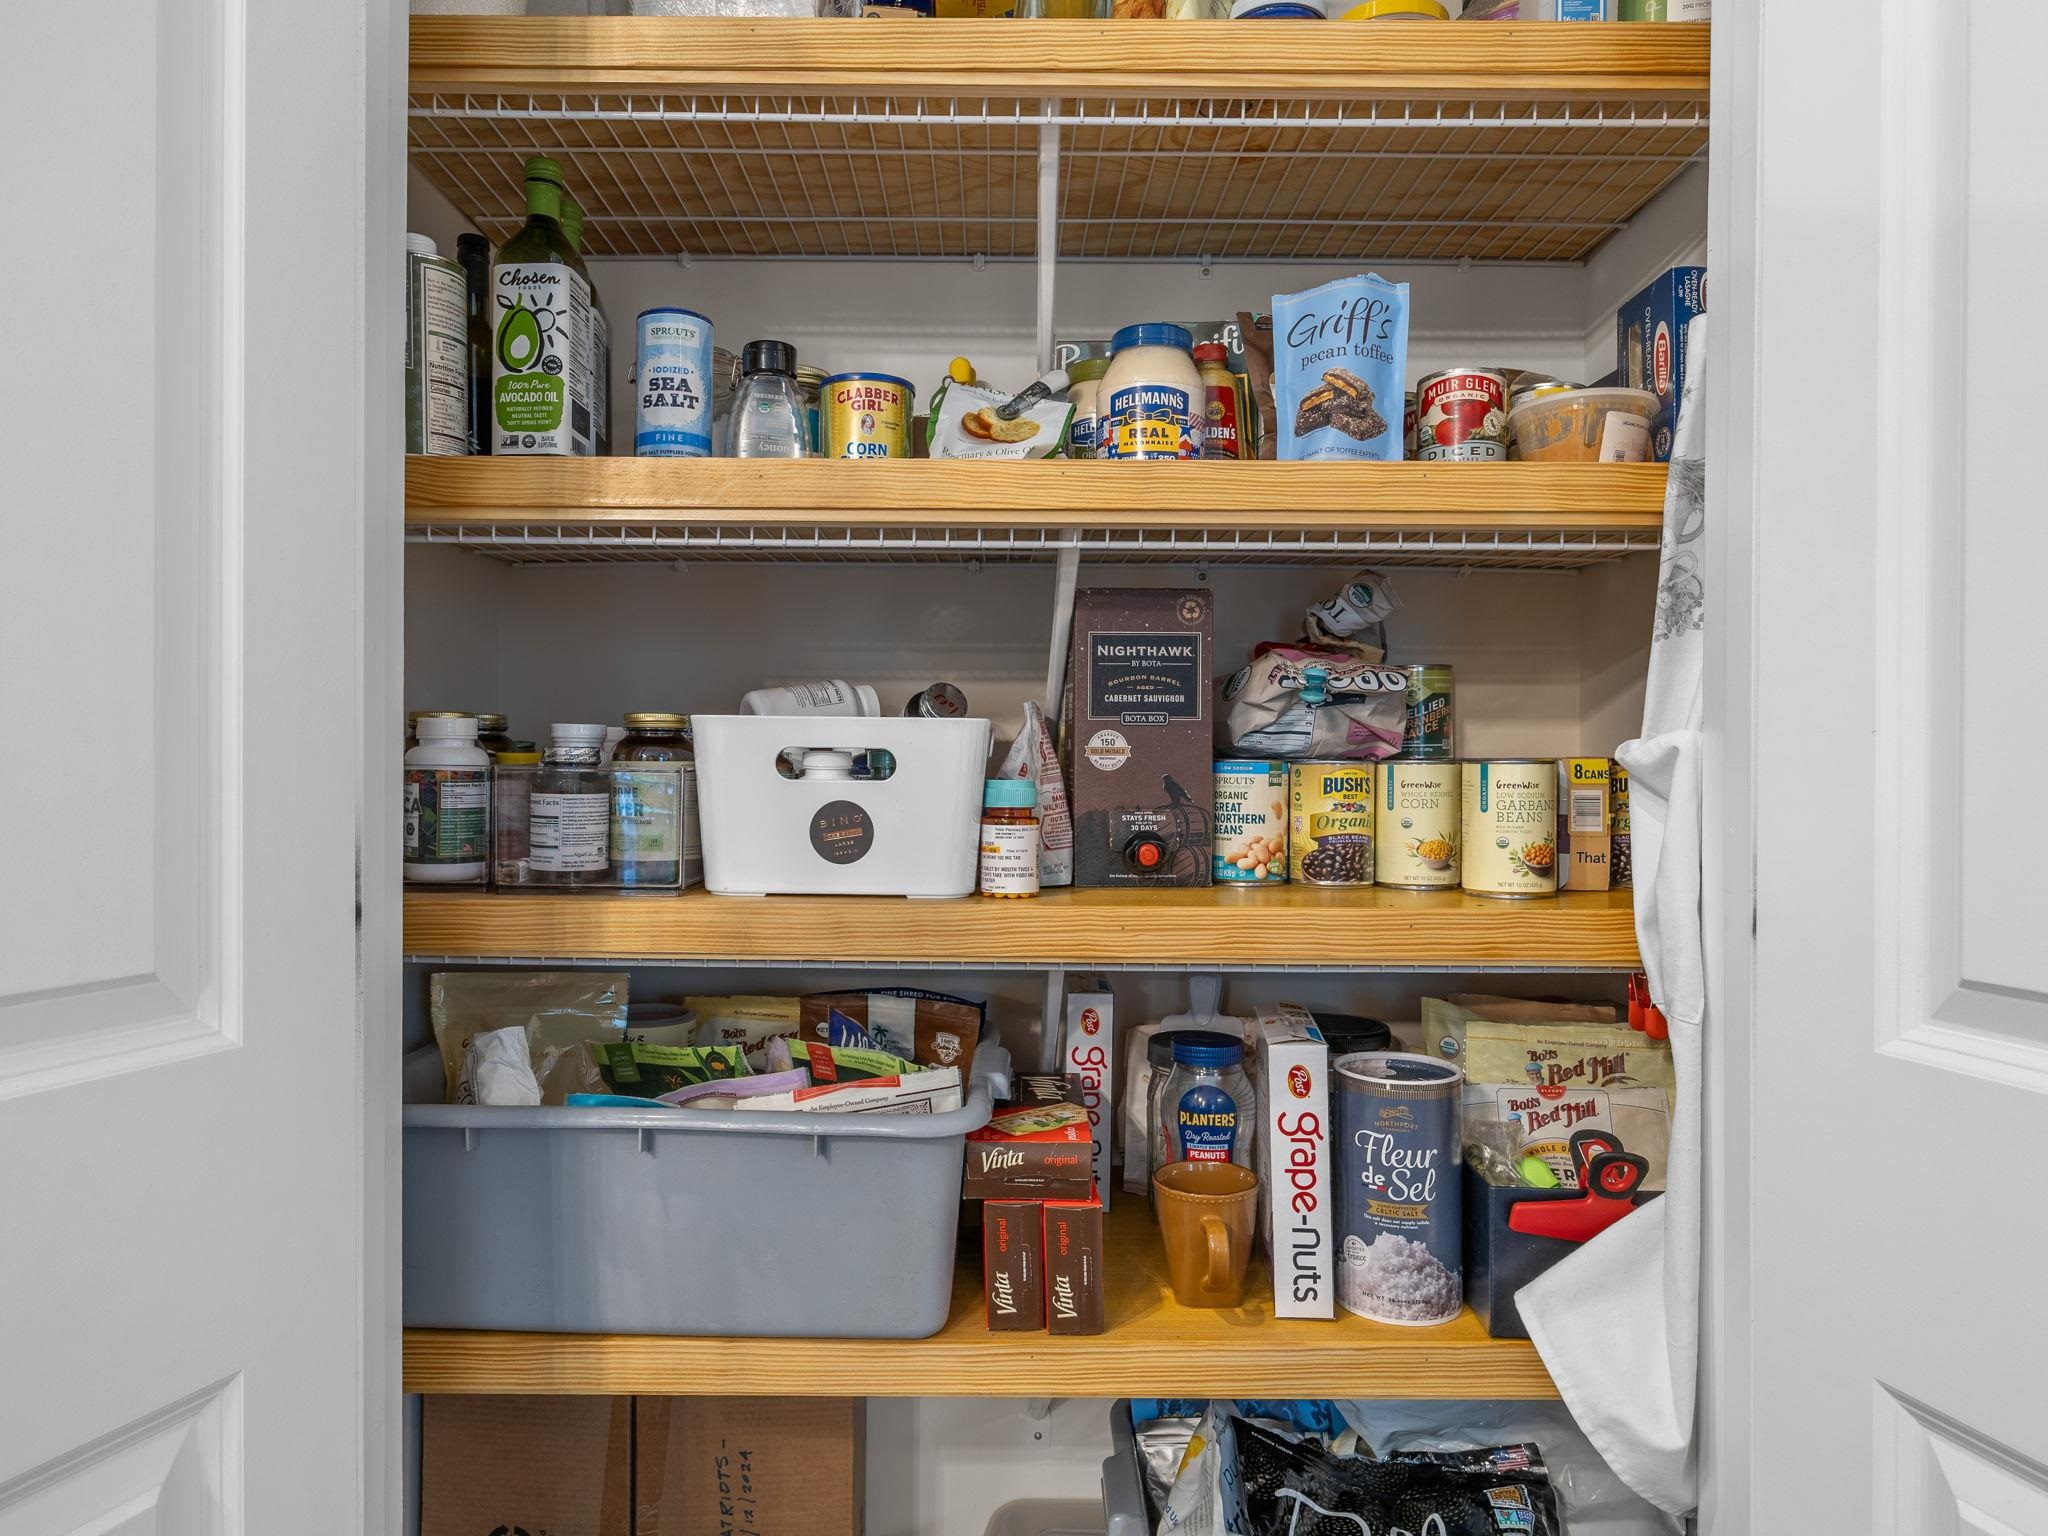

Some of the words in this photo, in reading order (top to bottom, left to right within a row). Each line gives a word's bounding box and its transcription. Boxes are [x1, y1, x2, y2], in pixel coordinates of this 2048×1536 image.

[500, 268, 561, 287] Chosen
[1691, 269, 1699, 314] OVEN-READY
[1287, 297, 1392, 348] Griff's
[650, 327, 696, 339] SPROUTS
[1301, 346, 1347, 370] pecan
[1354, 342, 1394, 365] toffee
[429, 362, 454, 374] Nutrition
[652, 366, 689, 374] IODIZED
[1658, 339, 1667, 390] Barilla
[430, 385, 451, 395] Calories
[507, 380, 529, 391] 100%
[530, 379, 551, 391] Pure
[649, 377, 693, 393] SEA
[1428, 379, 1459, 401] MUIR
[1466, 378, 1496, 395] GLEN
[499, 392, 543, 403] AVOCADO
[545, 391, 559, 402] OIL
[643, 393, 699, 410] SALT
[837, 387, 899, 406] CLABBER
[1115, 392, 1184, 411] HELLMANN'S
[1438, 392, 1485, 403] ORGANIC
[851, 399, 884, 412] GIRL
[655, 434, 684, 442] FINE
[1128, 428, 1169, 439] REAL
[847, 442, 888, 456] CORN
[942, 446, 984, 459] Rosemary
[995, 447, 1019, 456] Olive
[1324, 446, 1333, 454] OF
[1335, 446, 1357, 456] TOFFEE
[1358, 450, 1380, 459] EXPERTS
[1428, 446, 1494, 460] DICED
[1097, 645, 1193, 656] NIGHTHAWK
[1107, 675, 1147, 688] BOURBON
[1149, 675, 1181, 688] BARREL
[1104, 694, 1142, 703] CABERNET
[1143, 694, 1185, 703] SAUVIGNON
[1125, 714, 1144, 723] BOTA
[1146, 714, 1165, 723] BOX
[1100, 738, 1116, 747] 150
[1574, 764, 1583, 780] 8
[1584, 769, 1609, 780] CANS
[1214, 777, 1255, 785] SPROUTS
[1323, 777, 1371, 795] BUSH'S
[1401, 780, 1442, 789] GreenWise
[1496, 780, 1540, 789] GreenWise
[1214, 791, 1249, 801] ORGANIC
[542, 799, 559, 807] Facts
[1214, 802, 1243, 813] GREAT
[1401, 799, 1439, 809] CORN
[1214, 814, 1266, 825] NORTHERN
[1496, 812, 1543, 823] BEANS
[1214, 824, 1244, 835] BEANS
[1576, 852, 1607, 864] That
[898, 990, 924, 998] SHRED
[1083, 1011, 1098, 1034] Post
[720, 1028, 747, 1040] Bob's
[736, 1036, 766, 1056] Red
[1527, 1049, 1558, 1062] Bob's
[1547, 1057, 1586, 1086] Red
[1586, 1052, 1627, 1085] Mill
[1291, 1068, 1307, 1096] Post
[819, 1099, 864, 1110] Employee-Owned
[865, 1096, 889, 1105] Company
[1507, 1097, 1541, 1111] Bob's
[1180, 1111, 1235, 1127] PLANTERS
[1526, 1105, 1561, 1135] Red
[1561, 1098, 1597, 1128] Mill
[1374, 1121, 1419, 1131] NORTHPORT
[1185, 1130, 1201, 1144] Dry
[1201, 1131, 1231, 1141] Roasted
[1190, 1150, 1226, 1160] PEANUTS
[1354, 1129, 1437, 1169] Fleur
[1527, 1144, 1558, 1156] WHOLE
[981, 1147, 1025, 1174] Vinta
[1044, 1154, 1078, 1167] original
[1361, 1165, 1386, 1185] de
[1387, 1167, 1436, 1202] Sel
[1278, 1111, 1324, 1303] grape-nuts
[1375, 1208, 1399, 1217] CELTIC
[1379, 1222, 1400, 1230] necessary
[999, 1218, 1008, 1252] original
[1060, 1222, 1069, 1256] original
[1345, 1249, 1367, 1262] France
[991, 1272, 1017, 1314] Vinta
[1052, 1275, 1078, 1318] Vinta
